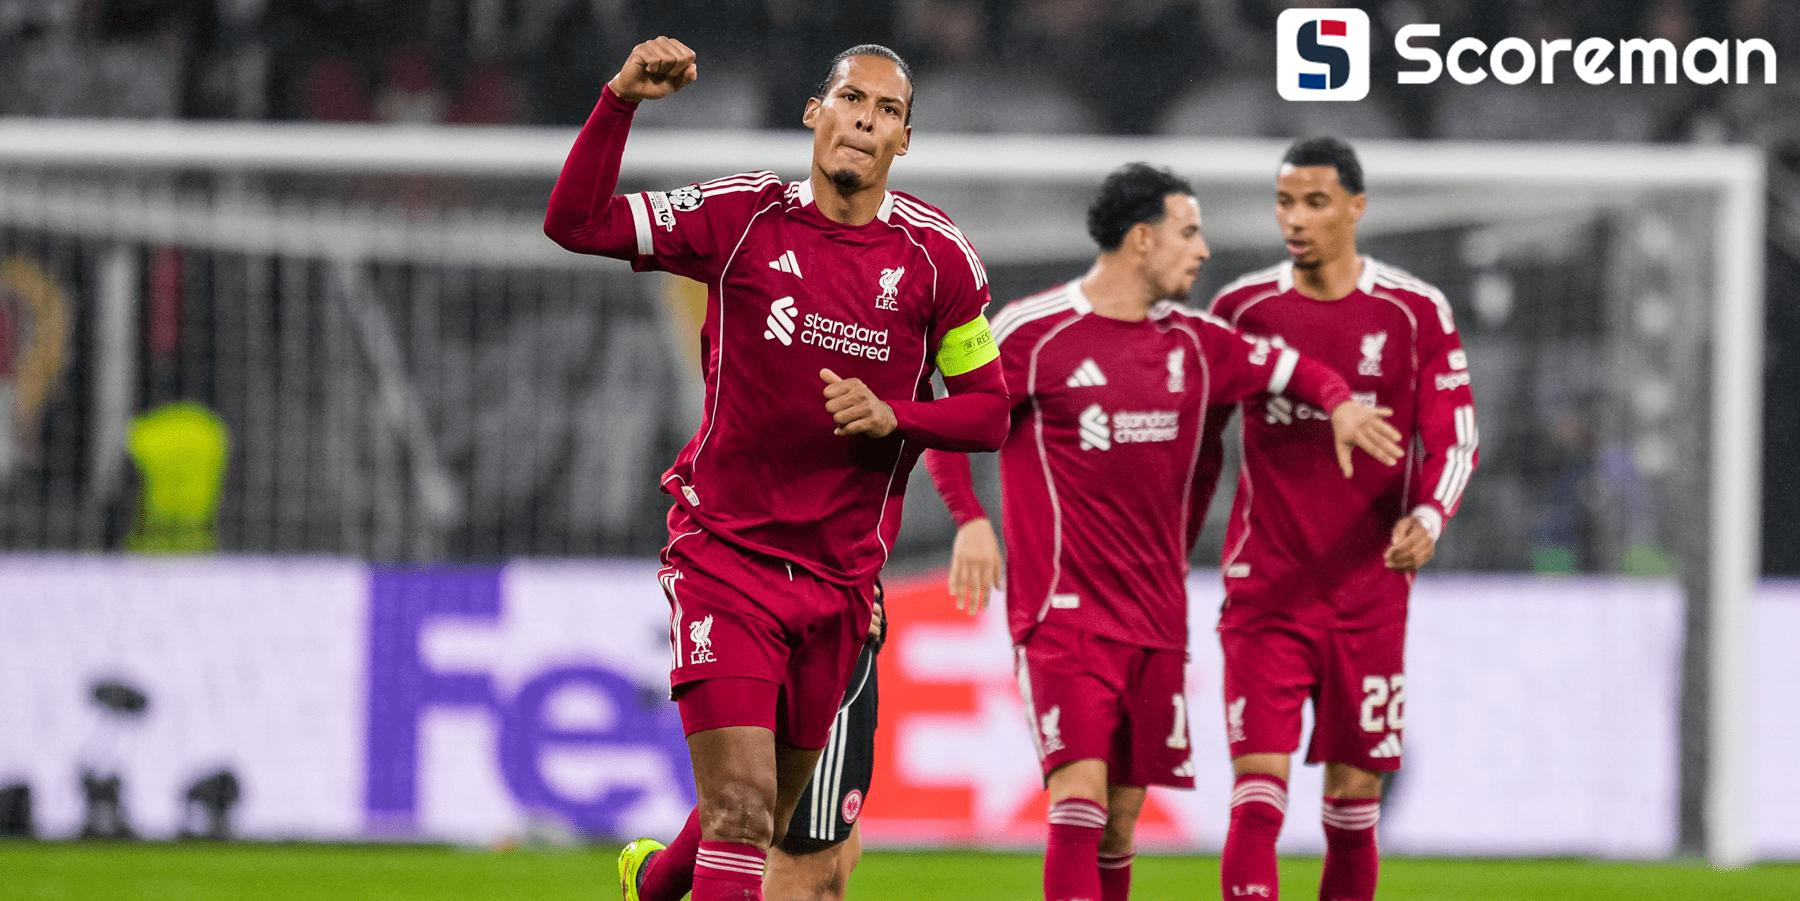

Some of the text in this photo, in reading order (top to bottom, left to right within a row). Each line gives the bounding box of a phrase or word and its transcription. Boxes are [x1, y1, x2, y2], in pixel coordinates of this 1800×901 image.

[803, 312, 889, 345] standard
[800, 330, 891, 362] chartered
[1360, 674, 1406, 733] 22
